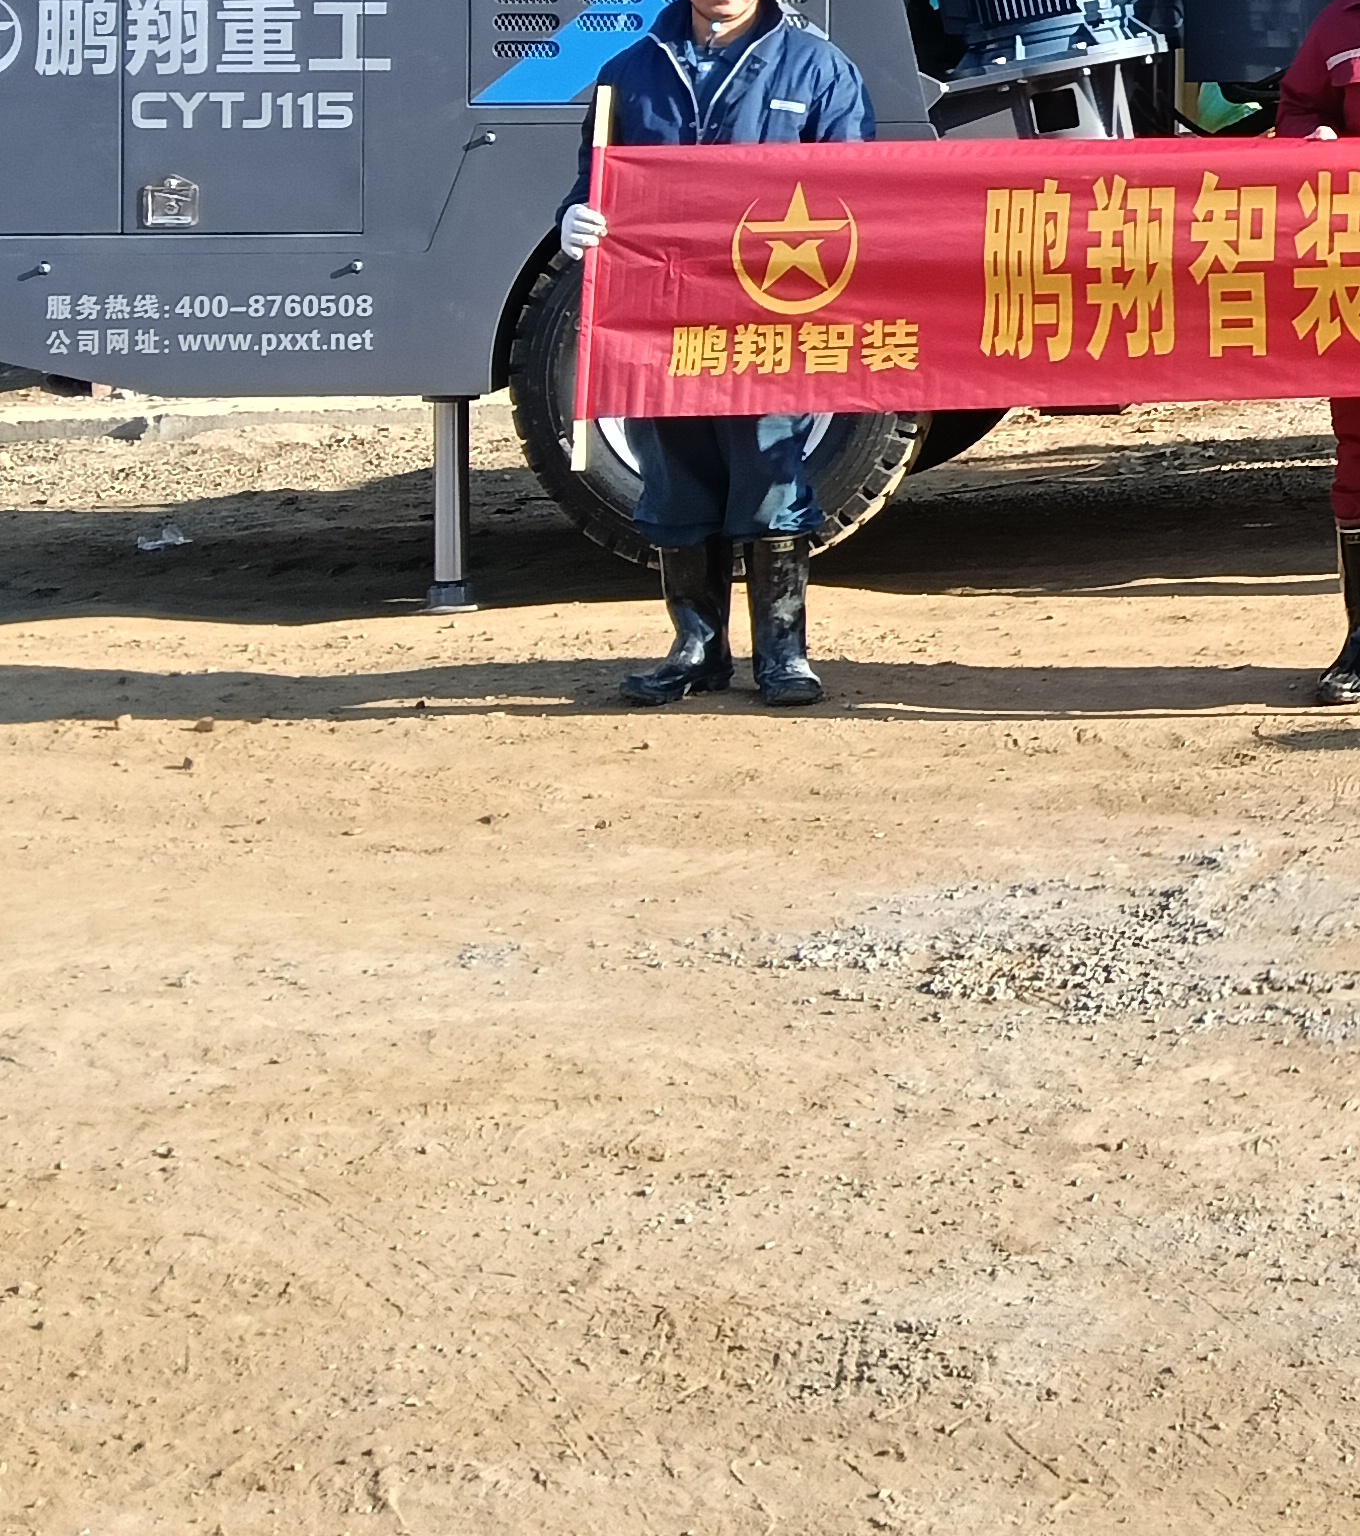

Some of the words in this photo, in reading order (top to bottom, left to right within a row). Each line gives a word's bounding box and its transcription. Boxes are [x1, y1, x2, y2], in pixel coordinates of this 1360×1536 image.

[131, 91, 354, 129] CYTJ115
[667, 318, 921, 378] 鹏翔智装
